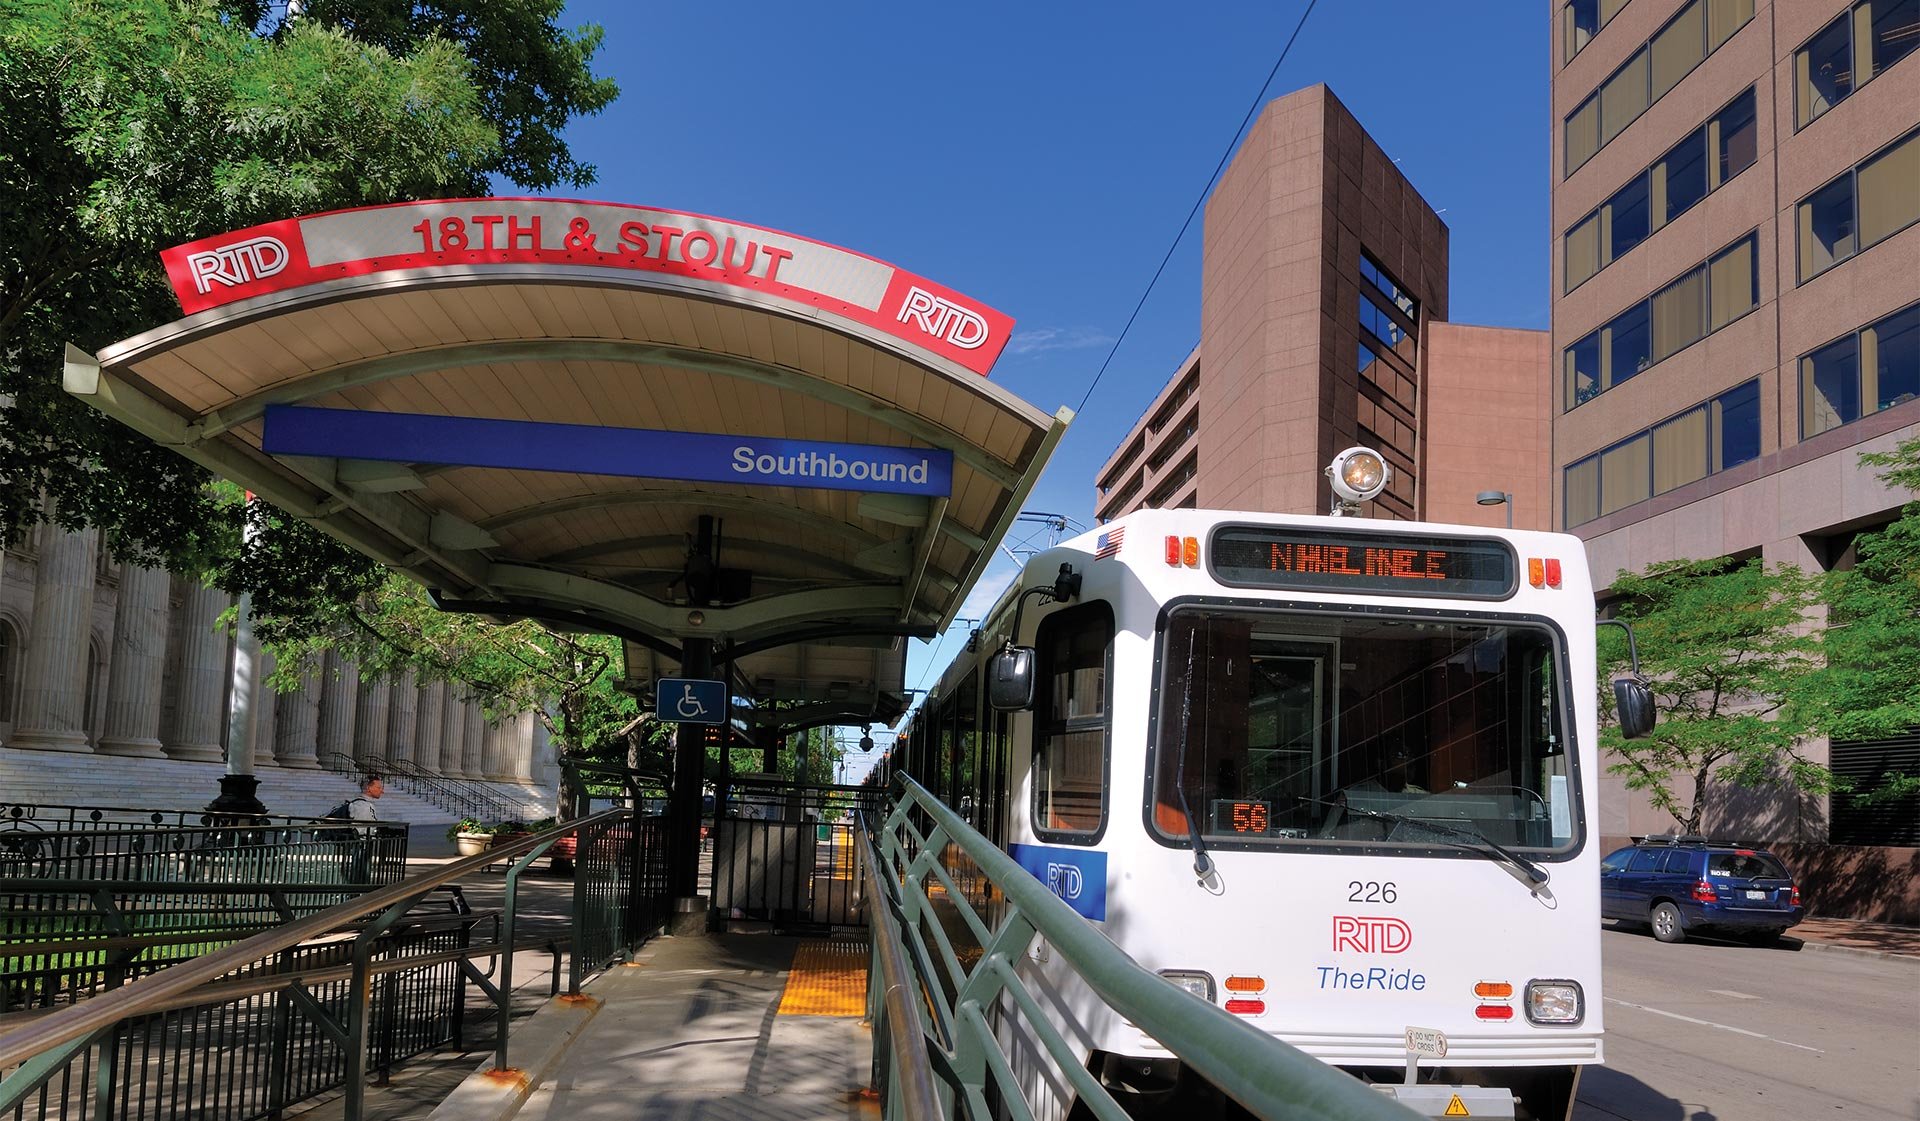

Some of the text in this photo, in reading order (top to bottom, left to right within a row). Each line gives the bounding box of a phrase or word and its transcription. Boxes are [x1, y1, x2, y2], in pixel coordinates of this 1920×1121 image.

[187, 236, 289, 294] RTD
[413, 215, 794, 283] 18TH & STOUT
[896, 286, 989, 349] RTD
[732, 446, 928, 484] Southbound
[1233, 803, 1267, 833] 56
[1046, 862, 1082, 899] RTD
[1348, 881, 1397, 904] 226
[1333, 916, 1412, 953] RTD
[1317, 967, 1426, 991] TheRide
[1416, 1032, 1435, 1042] DO NOT
[1417, 1042, 1435, 1052] CROSS
